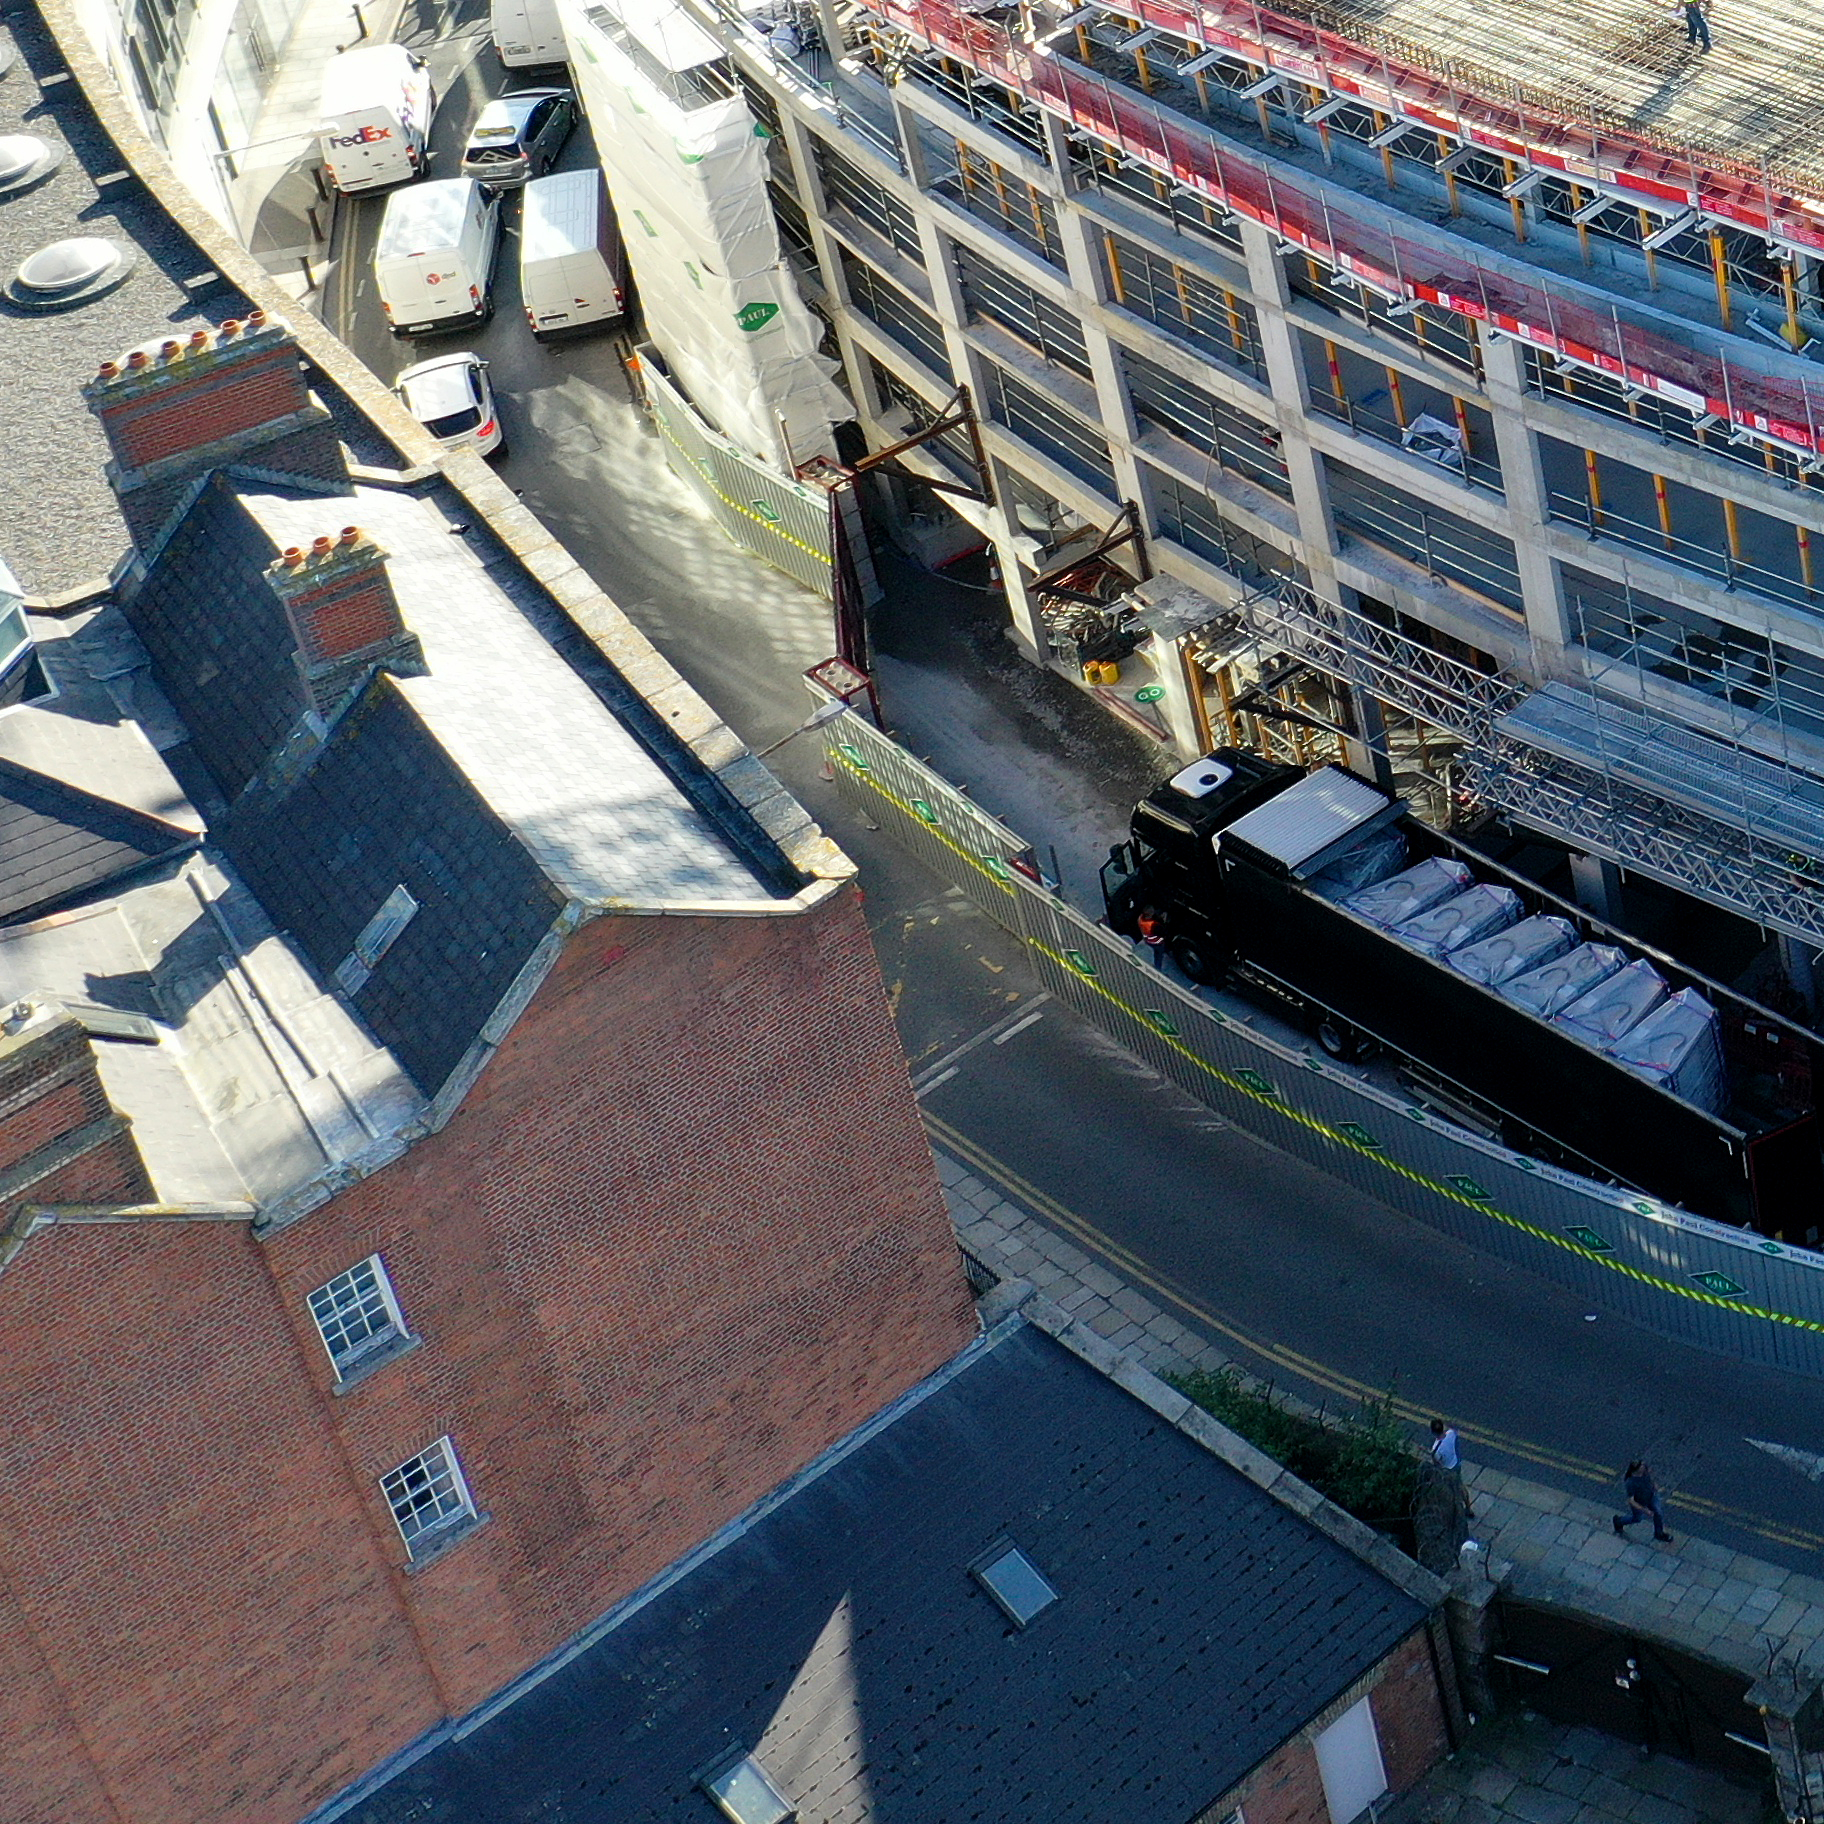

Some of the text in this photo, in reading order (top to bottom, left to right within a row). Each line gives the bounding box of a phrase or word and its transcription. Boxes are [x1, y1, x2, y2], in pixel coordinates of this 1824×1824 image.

[330, 126, 392, 149] FedEx
[739, 307, 770, 326] PAUL
[1706, 1277, 1732, 1291] PAUL
